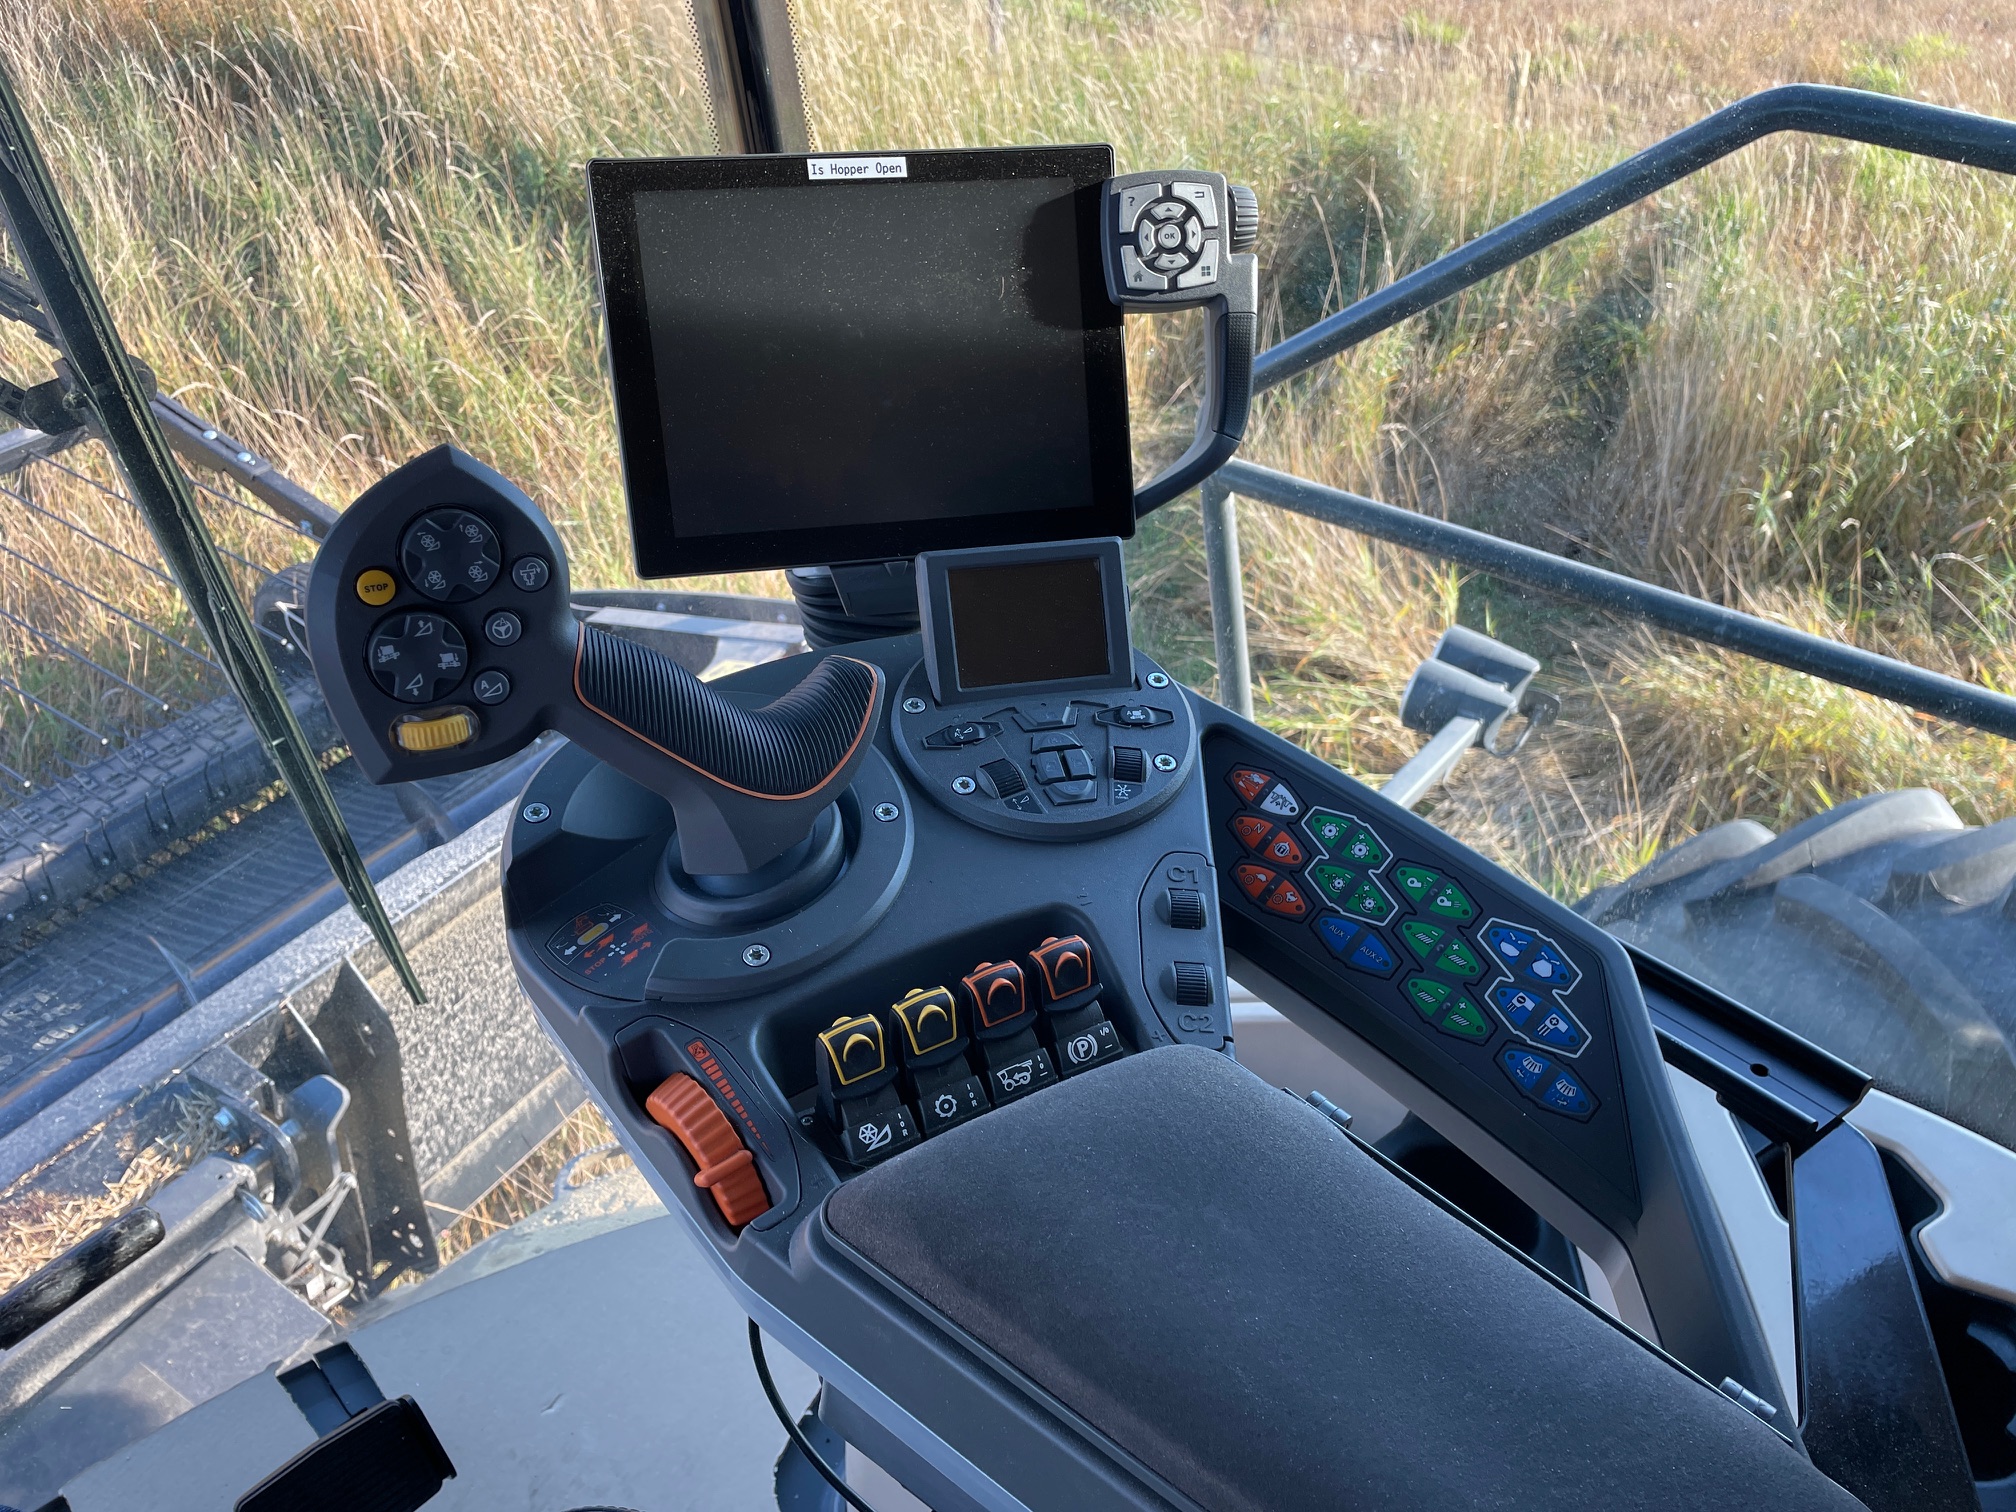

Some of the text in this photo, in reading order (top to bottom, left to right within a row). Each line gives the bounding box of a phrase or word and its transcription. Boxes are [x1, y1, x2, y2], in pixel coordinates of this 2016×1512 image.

[811, 162, 902, 176] Is Hopper Open
[1128, 196, 1136, 206] ?
[1164, 232, 1176, 240] OK
[364, 583, 389, 593] STOP
[481, 680, 489, 690] A
[1253, 823, 1265, 834] N
[1167, 865, 1199, 884] C1
[1328, 924, 1345, 938] AUX
[1359, 945, 1383, 964] AUX 2
[584, 957, 606, 975] STOP
[1178, 1012, 1215, 1033] C2
[1076, 1040, 1089, 1058] P
